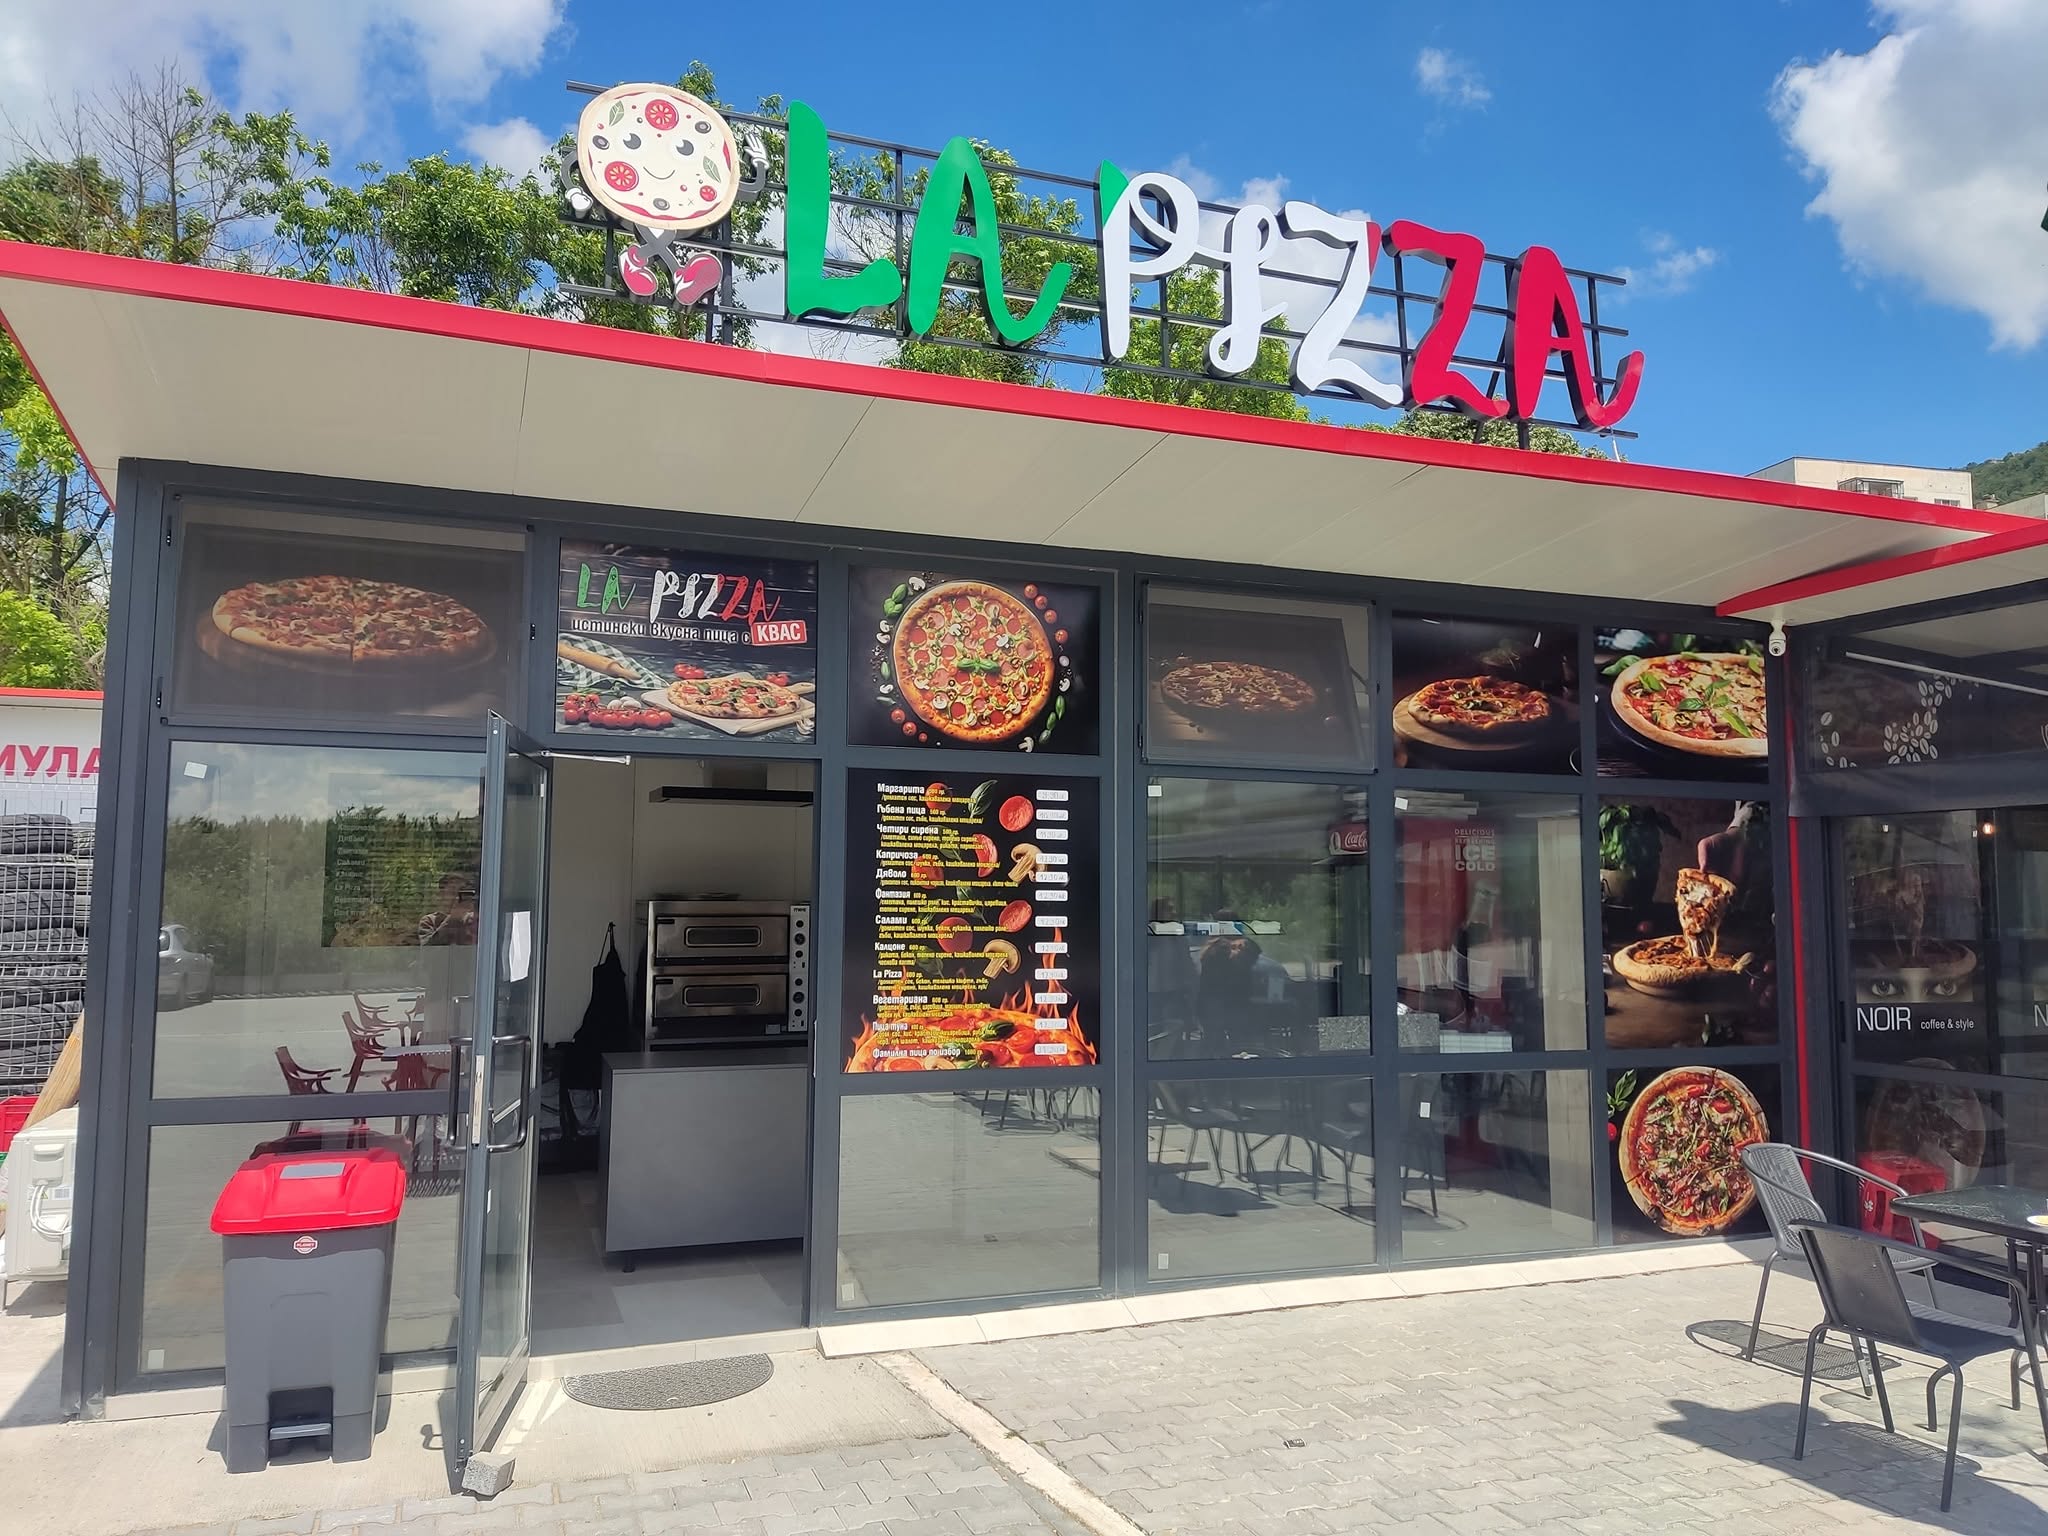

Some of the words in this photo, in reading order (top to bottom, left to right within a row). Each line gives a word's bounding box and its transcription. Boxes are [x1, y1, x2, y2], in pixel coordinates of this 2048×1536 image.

[785, 101, 1070, 346] LA
[1094, 159, 1644, 428] PIZZA
[577, 563, 636, 615] LA
[650, 570, 781, 626] PIZZA
[572, 617, 647, 637] истински
[650, 622, 699, 642] вкусна
[703, 630, 738, 645] пица
[756, 622, 801, 643] КВАС
[878, 784, 925, 795] Маргарита
[876, 804, 905, 814] Гъбена
[906, 807, 926, 816] пица
[876, 824, 909, 835] Четири
[910, 826, 938, 836] сирена
[876, 849, 918, 861] Капричоза
[1456, 845, 1496, 860] ICE
[1456, 862, 1496, 872] COLD
[876, 868, 907, 879] Дяволо
[875, 888, 911, 900] Фантазия
[875, 915, 908, 924] Салами
[875, 942, 906, 951] Калцоне
[873, 970, 882, 979] La
[884, 970, 902, 978] Pizza
[873, 995, 928, 1006] Вегетариана
[1856, 1006, 1912, 1031] NOIR
[1920, 1018, 1946, 1030] coffee
[1947, 1018, 1954, 1029] &
[1955, 1018, 1974, 1032] style
[873, 1021, 889, 1031] Пица
[890, 1022, 908, 1031] туна
[873, 1048, 908, 1059] Фамилна
[940, 1048, 960, 1057] избор
